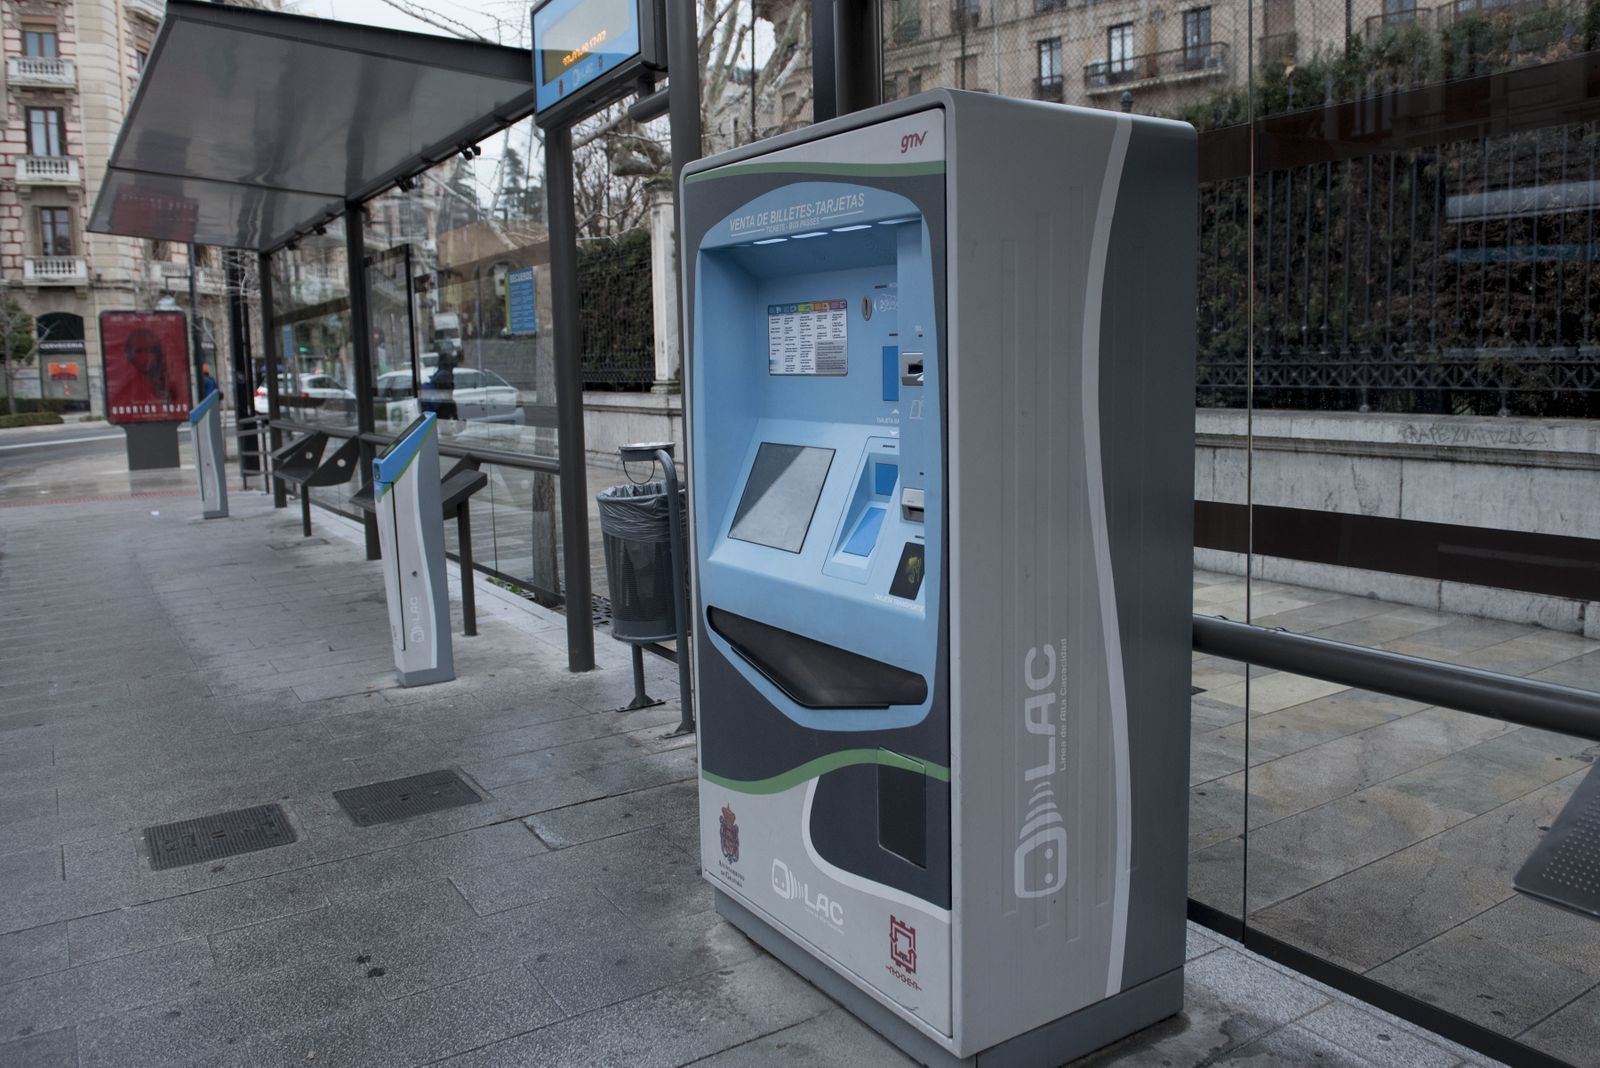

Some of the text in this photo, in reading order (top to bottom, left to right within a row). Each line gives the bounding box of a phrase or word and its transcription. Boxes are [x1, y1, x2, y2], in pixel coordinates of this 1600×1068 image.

[730, 215, 755, 231] VENTA
[757, 212, 769, 226] DE
[162, 403, 189, 412] ROJO
[1024, 643, 1057, 781] LAC
[804, 883, 844, 926] LAC
